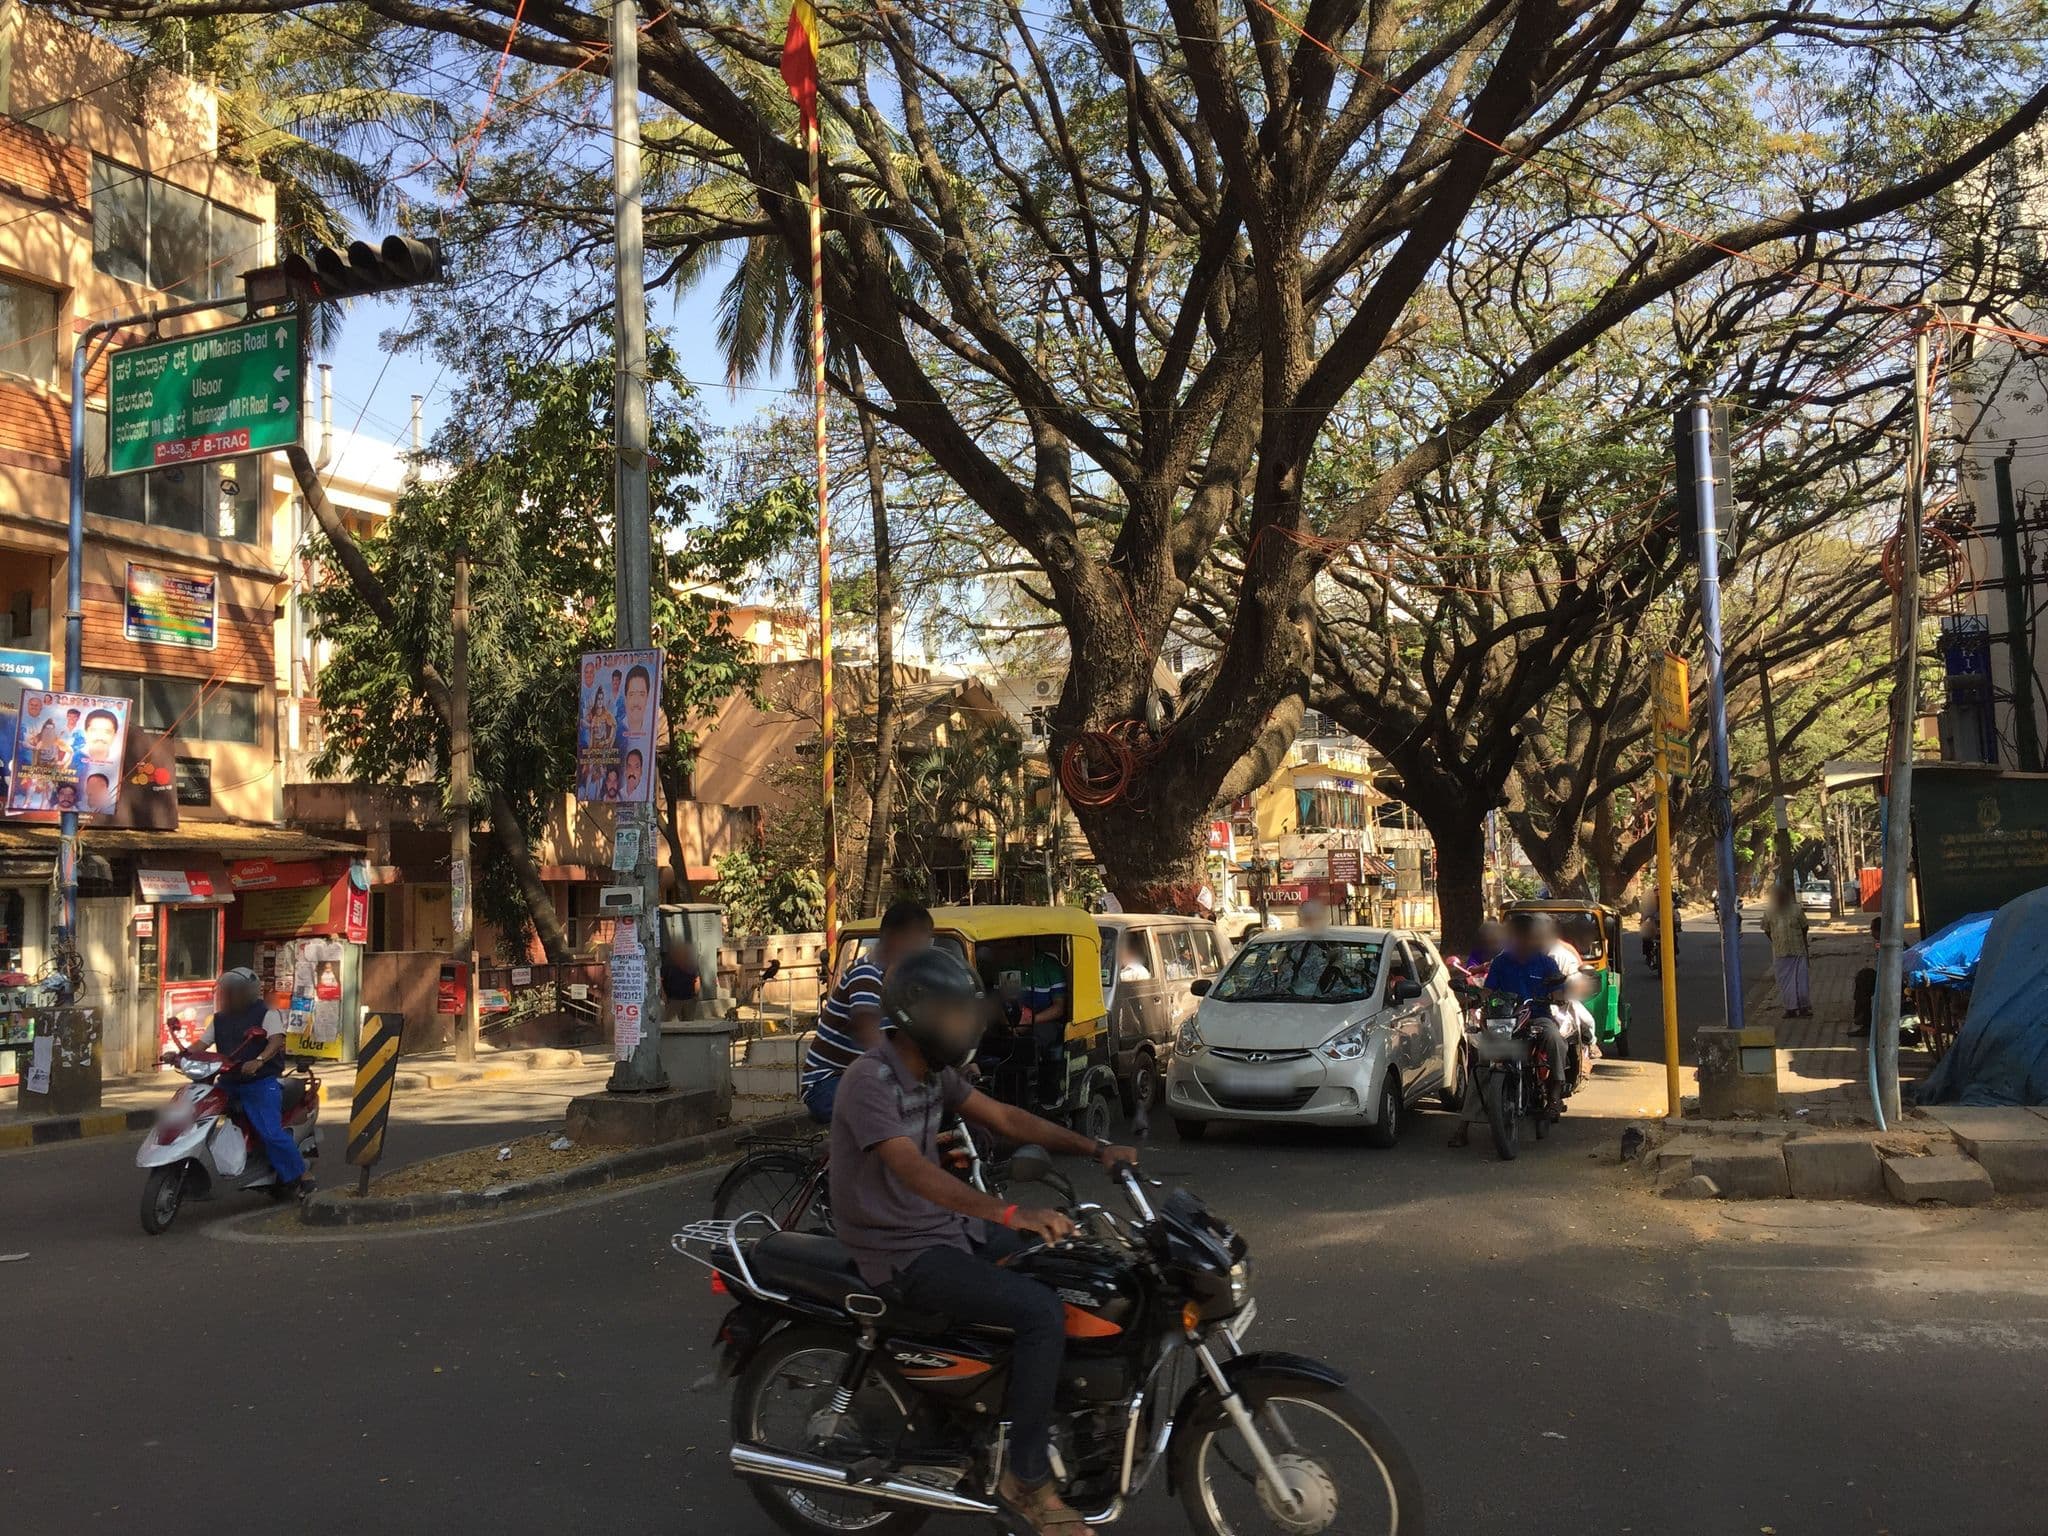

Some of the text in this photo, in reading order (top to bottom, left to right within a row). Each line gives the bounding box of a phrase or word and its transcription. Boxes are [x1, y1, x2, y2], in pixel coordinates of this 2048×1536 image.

[192, 329, 268, 362] Old Madras Road
[192, 379, 223, 398] Ulsoor
[192, 394, 268, 426] Indiranagar 100 Ft Road
[204, 433, 248, 453] B-TRAC
[290, 1013, 303, 1027] 25
